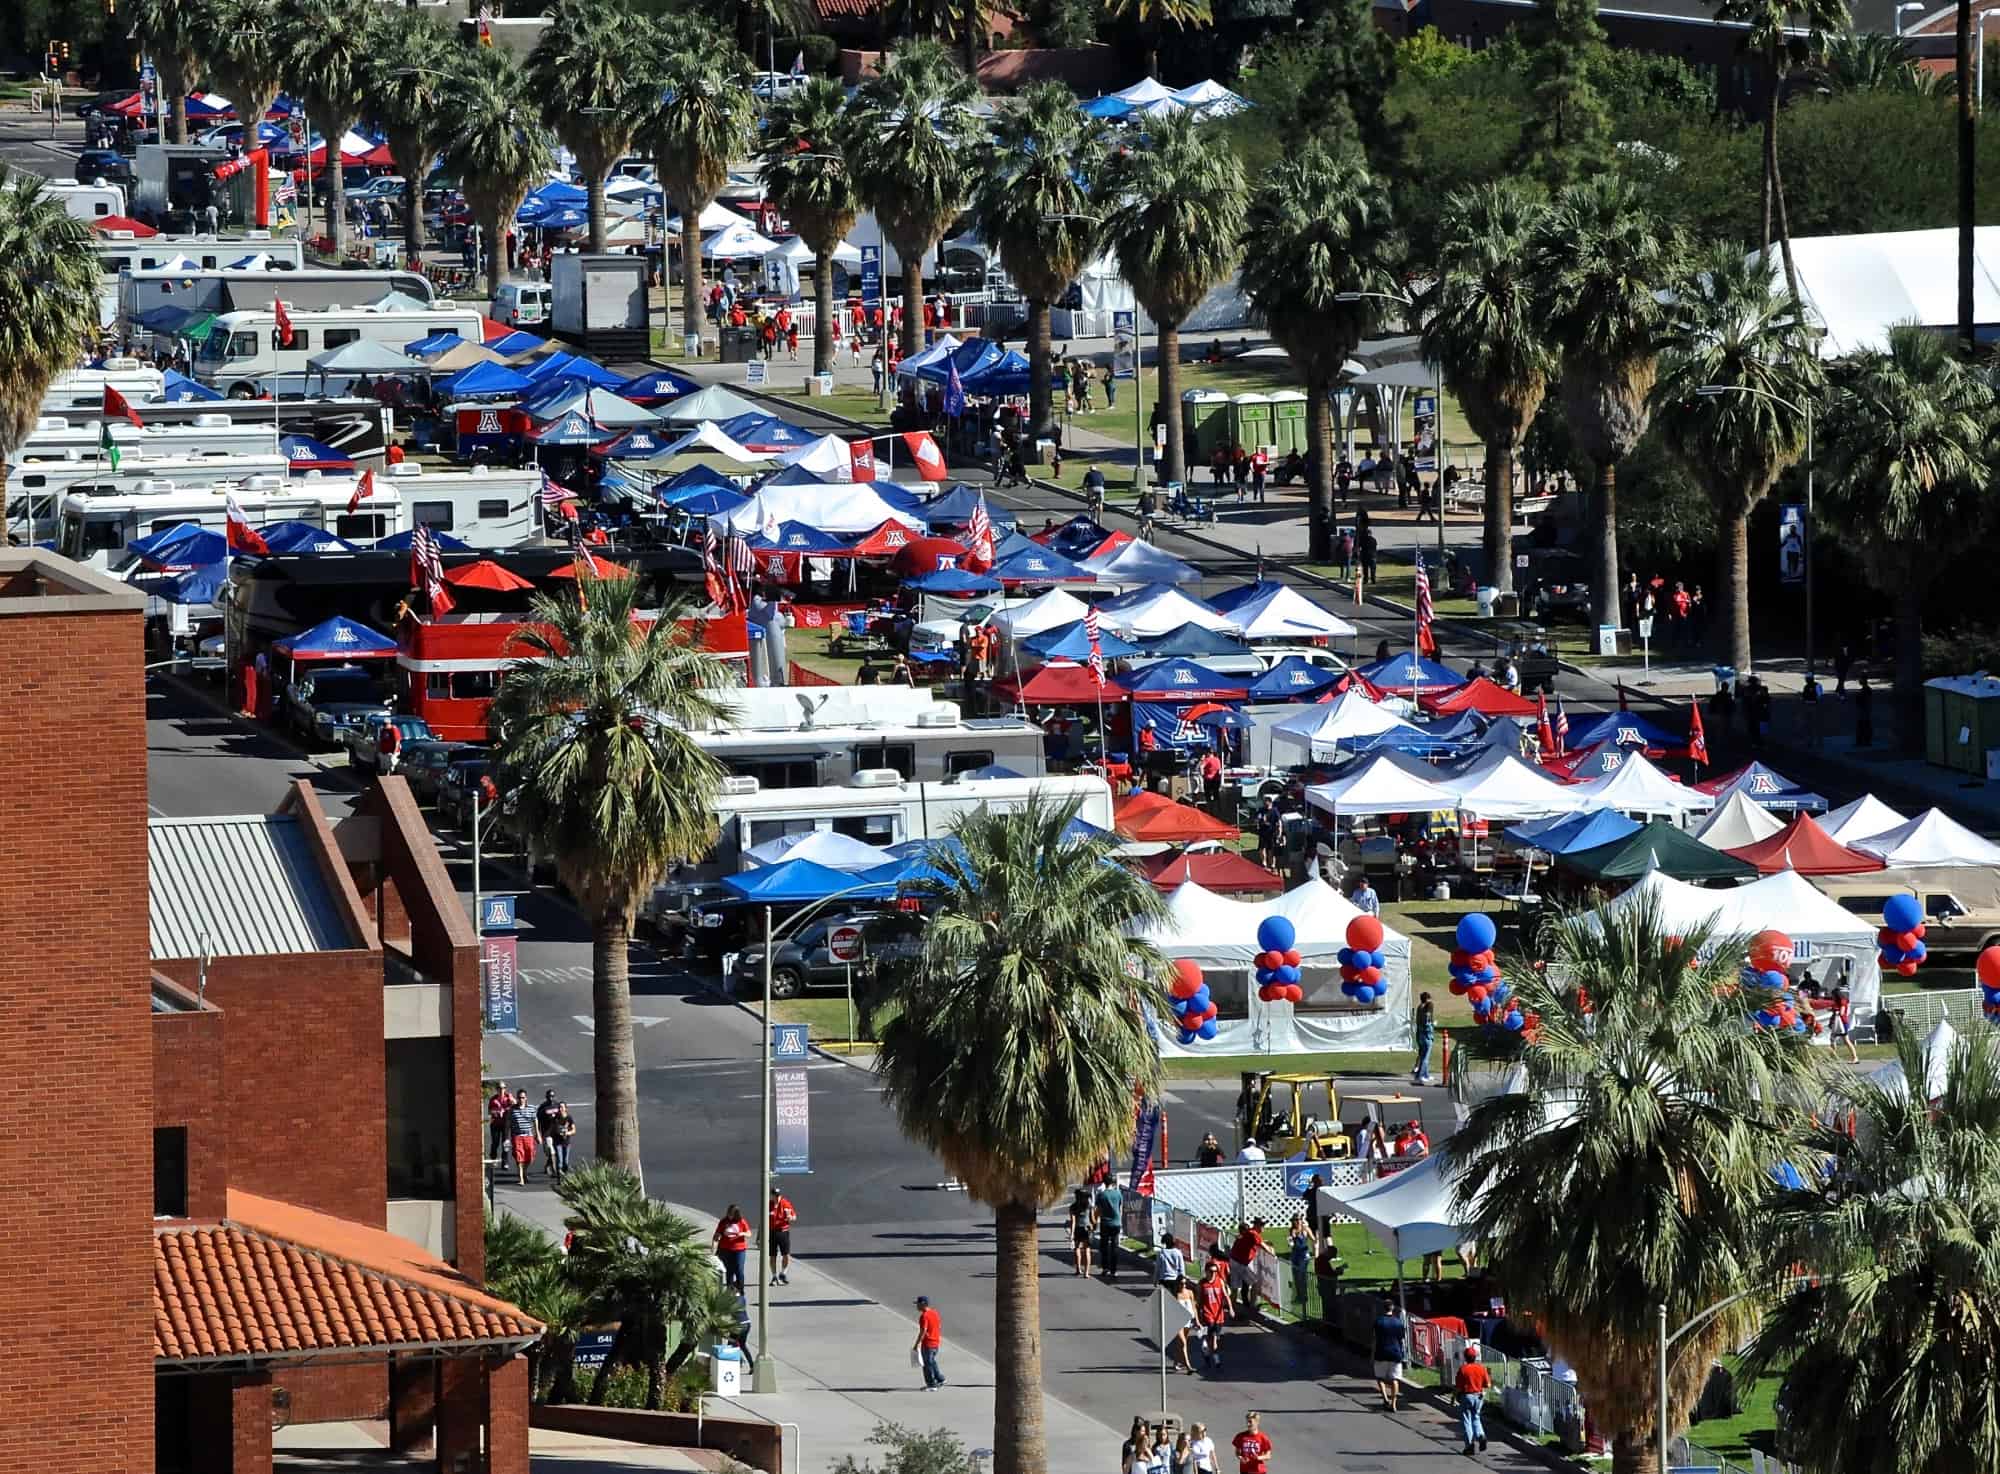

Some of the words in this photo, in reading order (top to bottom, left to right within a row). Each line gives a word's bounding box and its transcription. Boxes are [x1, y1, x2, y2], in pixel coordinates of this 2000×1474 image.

[477, 410, 502, 433] A
[567, 420, 585, 435] A
[292, 446, 317, 460] A
[887, 530, 909, 547] A
[335, 627, 358, 642] A
[1174, 668, 1198, 684] A
[1616, 728, 1647, 745] A
[1602, 753, 1624, 772] A
[1751, 774, 1782, 794] A
[487, 902, 512, 925] A
[502, 952, 513, 998] ARIZONA
[490, 1003, 502, 1021] THE
[777, 1029, 804, 1055] A
[775, 1073, 789, 1081] WE
